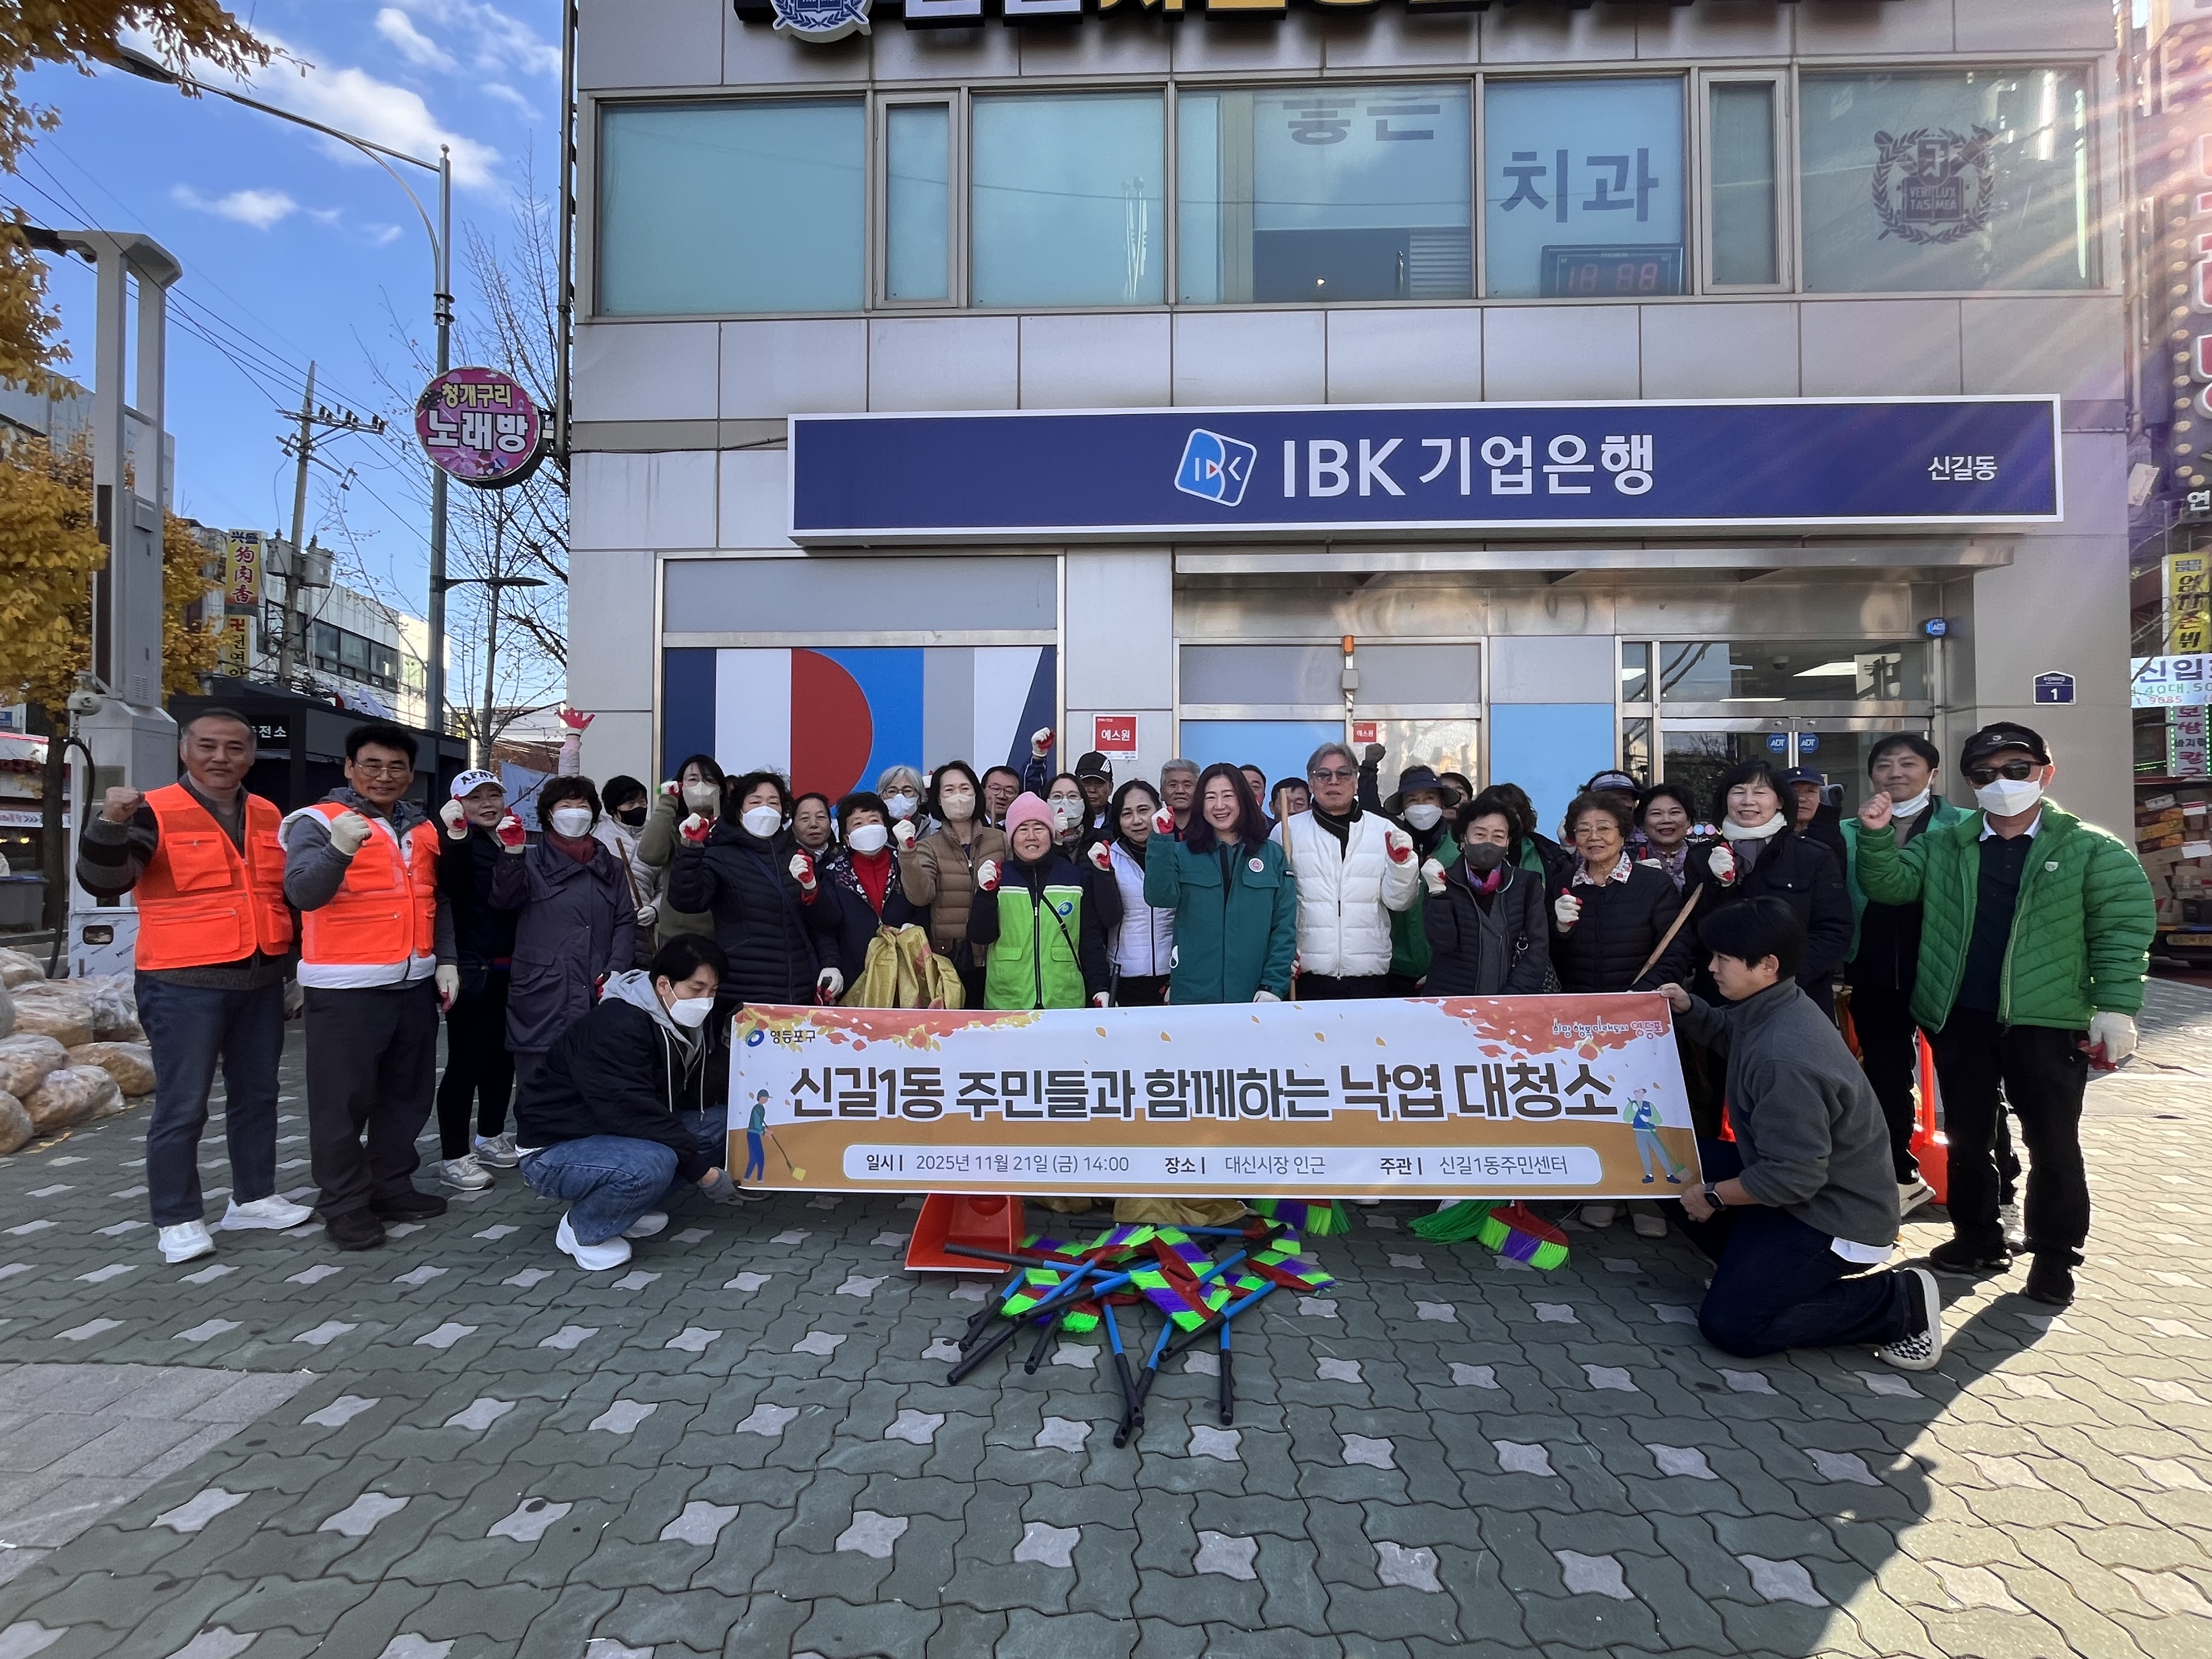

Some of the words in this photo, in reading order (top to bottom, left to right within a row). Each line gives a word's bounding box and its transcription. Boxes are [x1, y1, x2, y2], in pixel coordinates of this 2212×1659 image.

[1500, 149, 1659, 223] 치과
[1910, 199, 1931, 210] TAS
[442, 383, 512, 408] 청개구리
[427, 410, 528, 453] 노래방
[1284, 439, 1405, 497] IBK
[1419, 435, 1653, 495] 기업은행
[1928, 456, 1997, 481] 신길동
[2140, 658, 2212, 683] 신입
[2051, 688, 2057, 701] 1
[1101, 729, 1130, 741] 에스원
[770, 1030, 815, 1044] 영등포구
[1630, 1020, 1663, 1039] 영등포
[791, 1067, 945, 1119] 신길1동
[956, 1070, 1136, 1118] 주민들과
[1144, 1068, 1329, 1118] 함께하는
[1341, 1064, 1444, 1118] 낙엽
[1454, 1062, 1618, 1118] 대청소
[916, 1154, 969, 1172] 2025년
[975, 1154, 1008, 1172] 11월
[1013, 1155, 1048, 1173] 21일
[1084, 1156, 1129, 1171] 14:00
[1225, 1155, 1289, 1175] 대신시장
[1294, 1156, 1326, 1174] 인근
[1440, 1155, 1568, 1175] 신길1동주민센터
